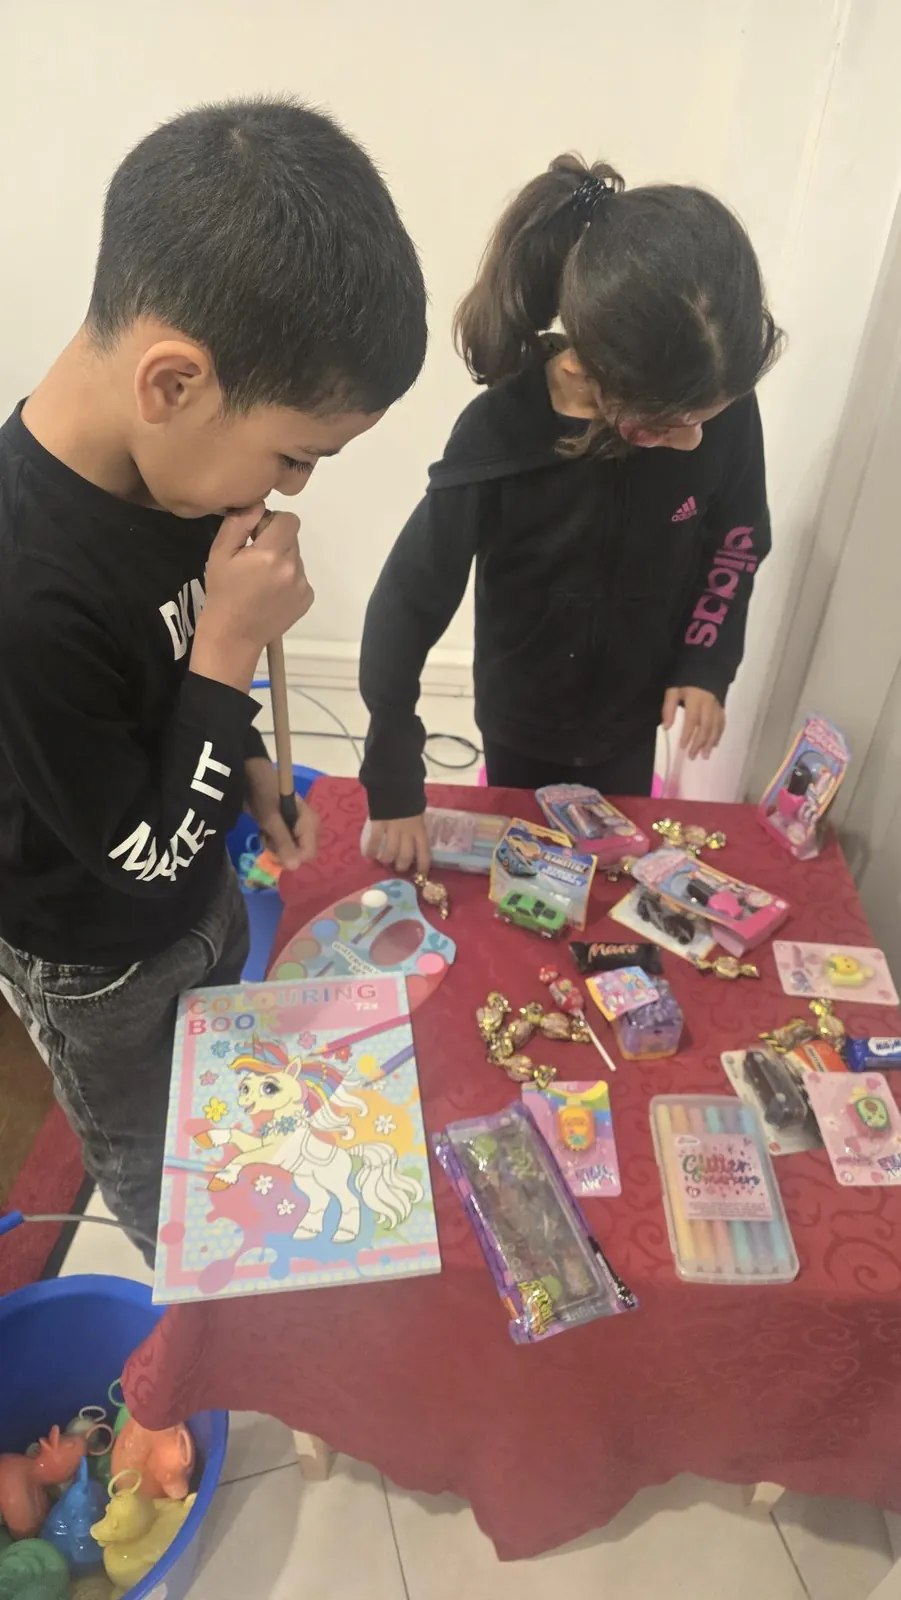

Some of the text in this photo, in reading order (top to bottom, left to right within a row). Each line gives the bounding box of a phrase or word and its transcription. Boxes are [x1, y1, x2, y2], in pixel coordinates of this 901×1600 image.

[190, 741, 231, 801] IT
[588, 943, 639, 963] Mars
[188, 984, 377, 1015] COLOURING
[187, 1013, 281, 1036] BOOK
